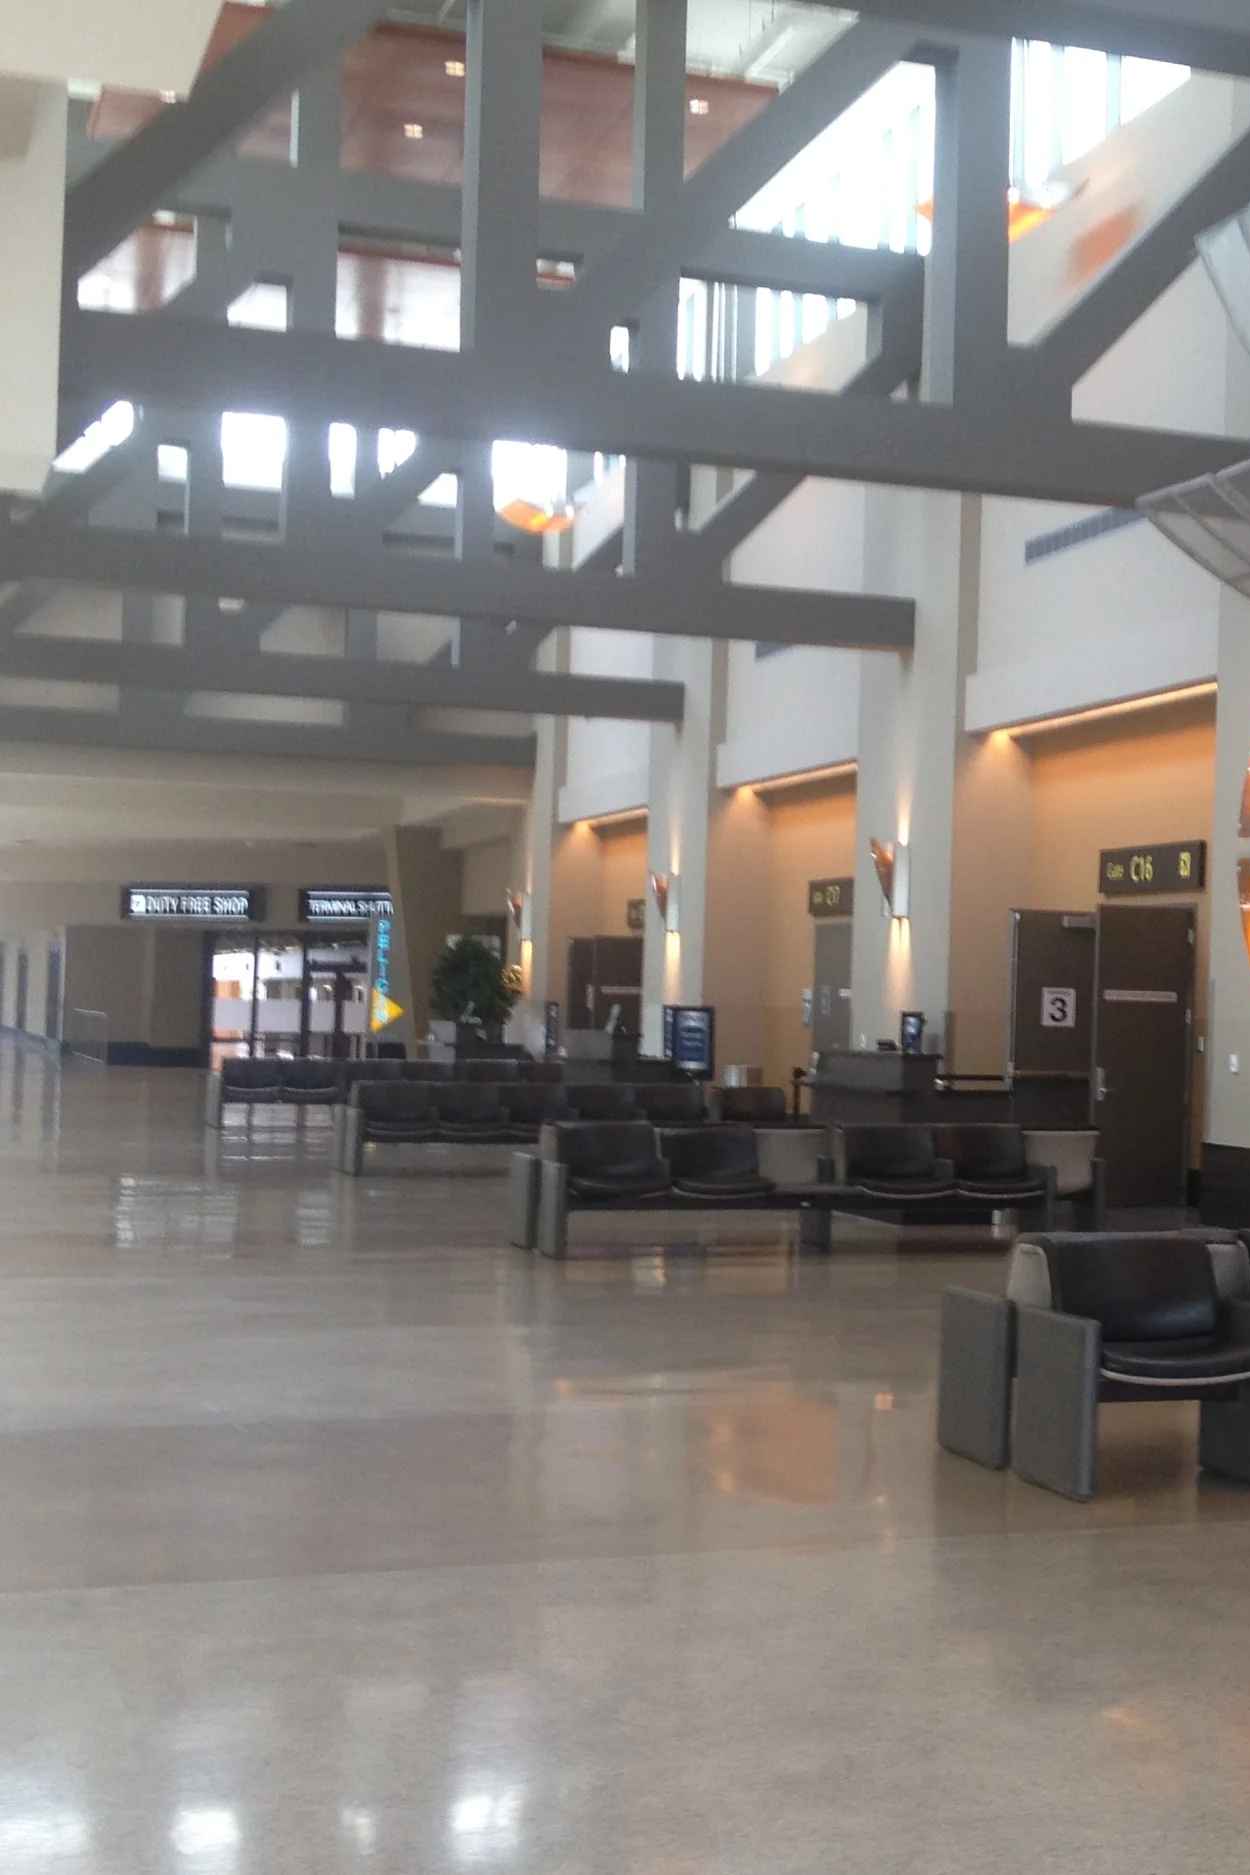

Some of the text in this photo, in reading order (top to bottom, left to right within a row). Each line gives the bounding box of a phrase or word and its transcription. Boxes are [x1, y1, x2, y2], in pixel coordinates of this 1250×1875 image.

[1130, 854, 1154, 883] C16
[146, 895, 249, 915] DUTY FREE SHOP
[308, 899, 357, 915] TERMINAL
[1049, 996, 1068, 1022] 3
